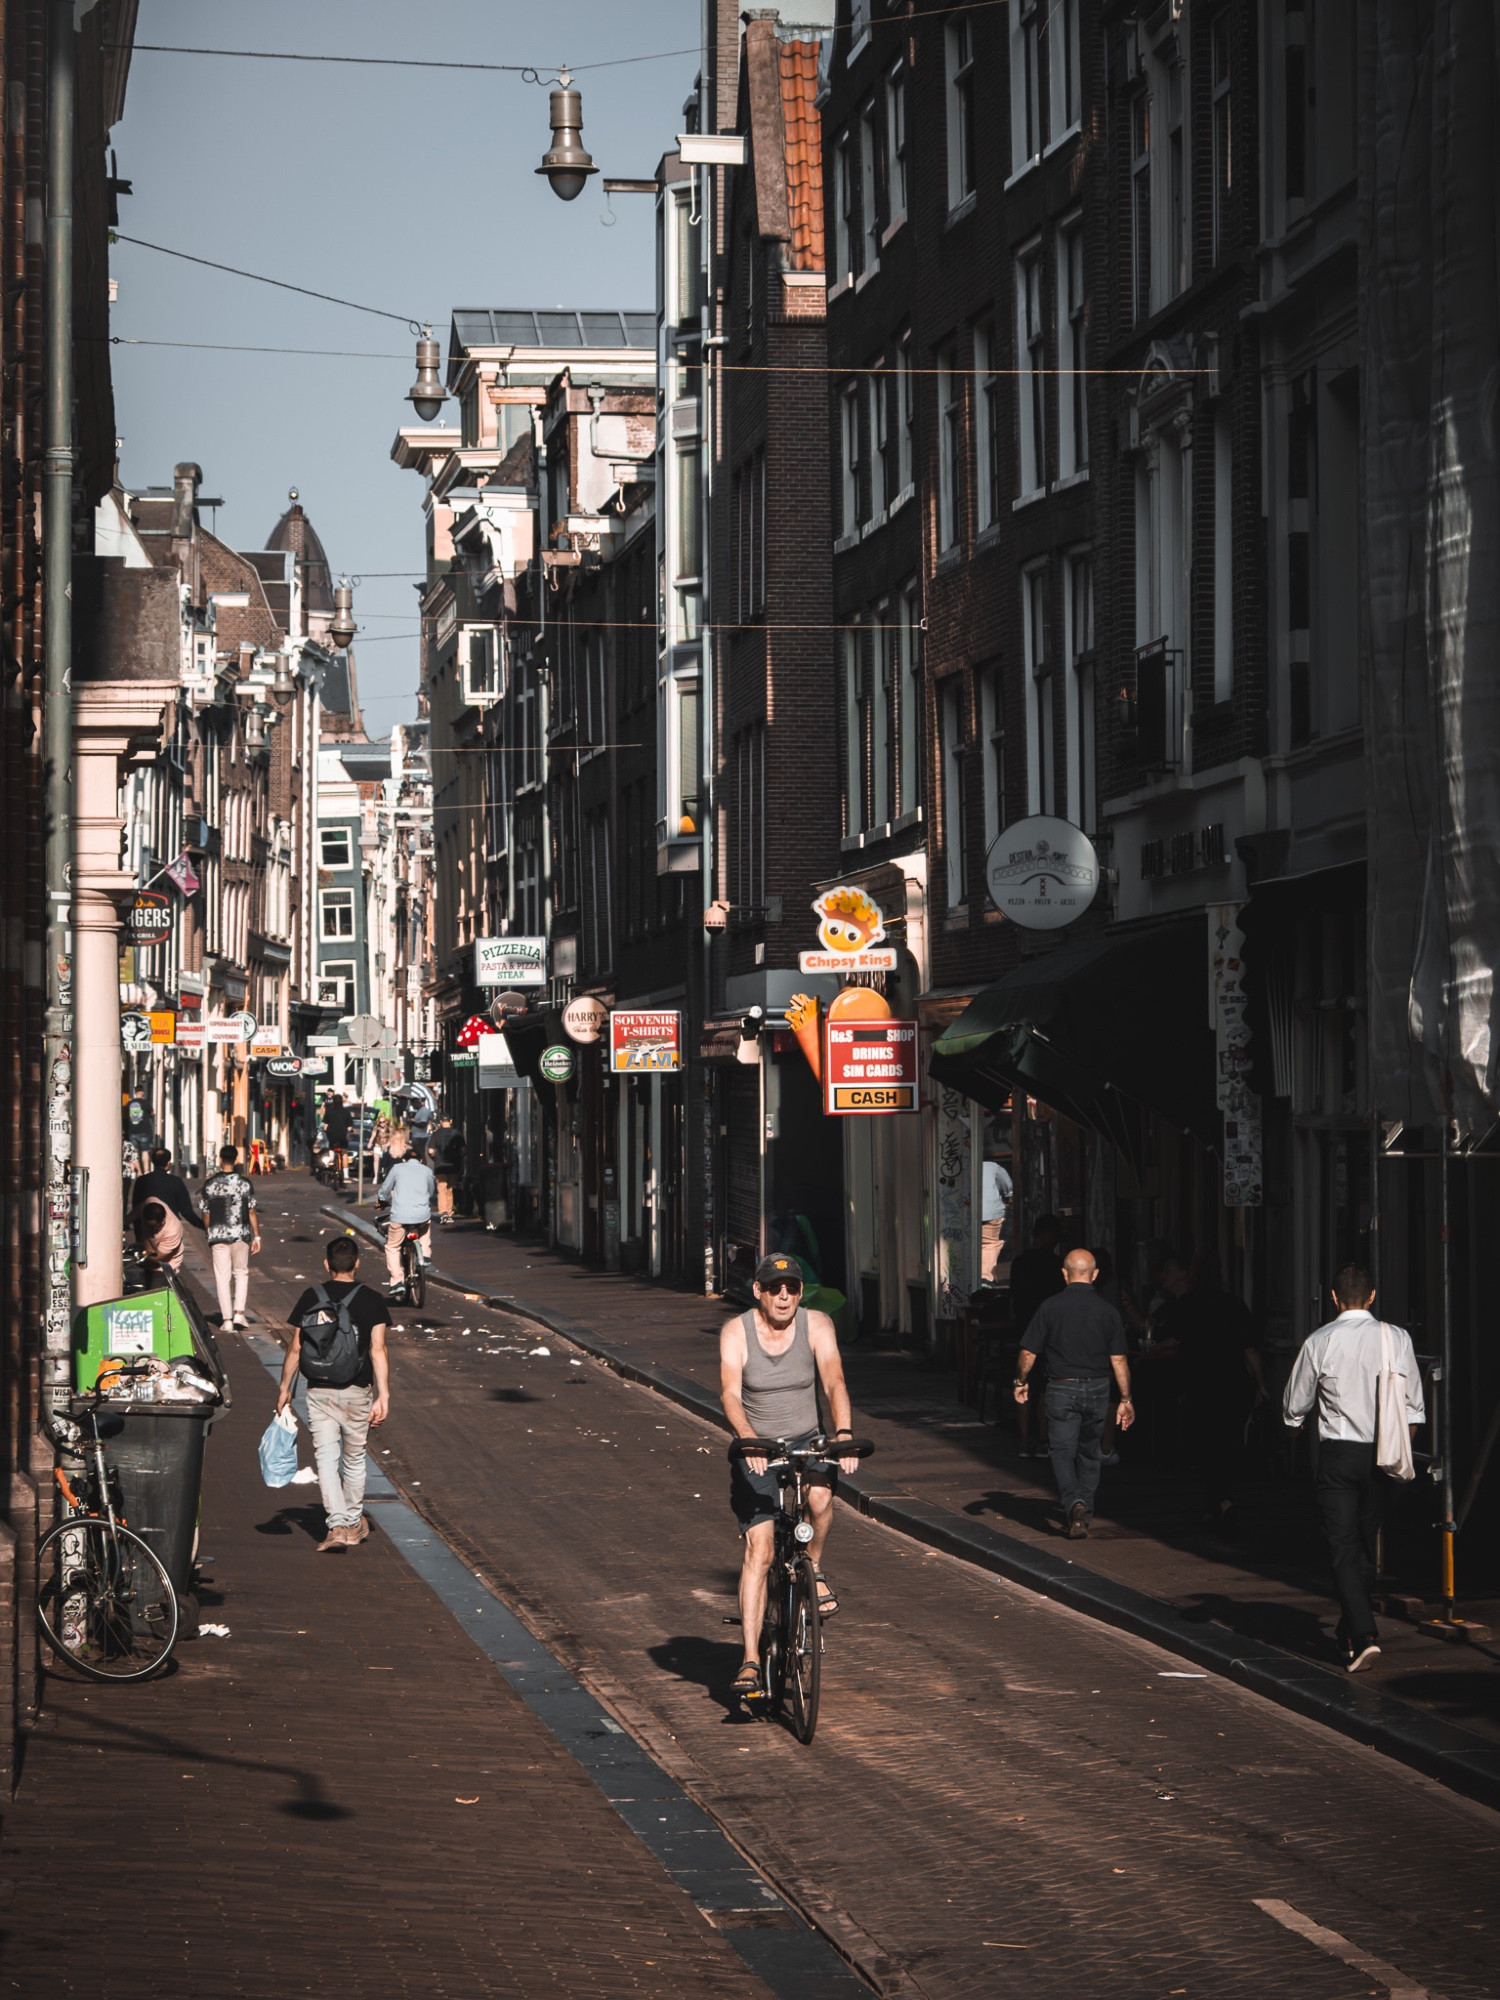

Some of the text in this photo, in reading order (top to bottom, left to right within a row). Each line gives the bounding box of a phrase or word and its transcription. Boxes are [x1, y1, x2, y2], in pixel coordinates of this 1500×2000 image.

[127, 908, 171, 927] RGERS
[481, 943, 541, 961] PIZZERIA
[481, 961, 541, 971] PASTA & PIZZA
[805, 954, 892, 968] Chipsy King
[497, 971, 525, 979] STEAK
[614, 1015, 679, 1025] SOUVENIRS
[621, 1026, 674, 1037] T-SHIRTS
[830, 1029, 914, 1043] R&S SHOP
[852, 1047, 894, 1060] DRINKS
[271, 1062, 298, 1072] WOK
[626, 1053, 672, 1068] ATM
[843, 1064, 903, 1077] SIM CARDS
[851, 1091, 897, 1104] CASH
